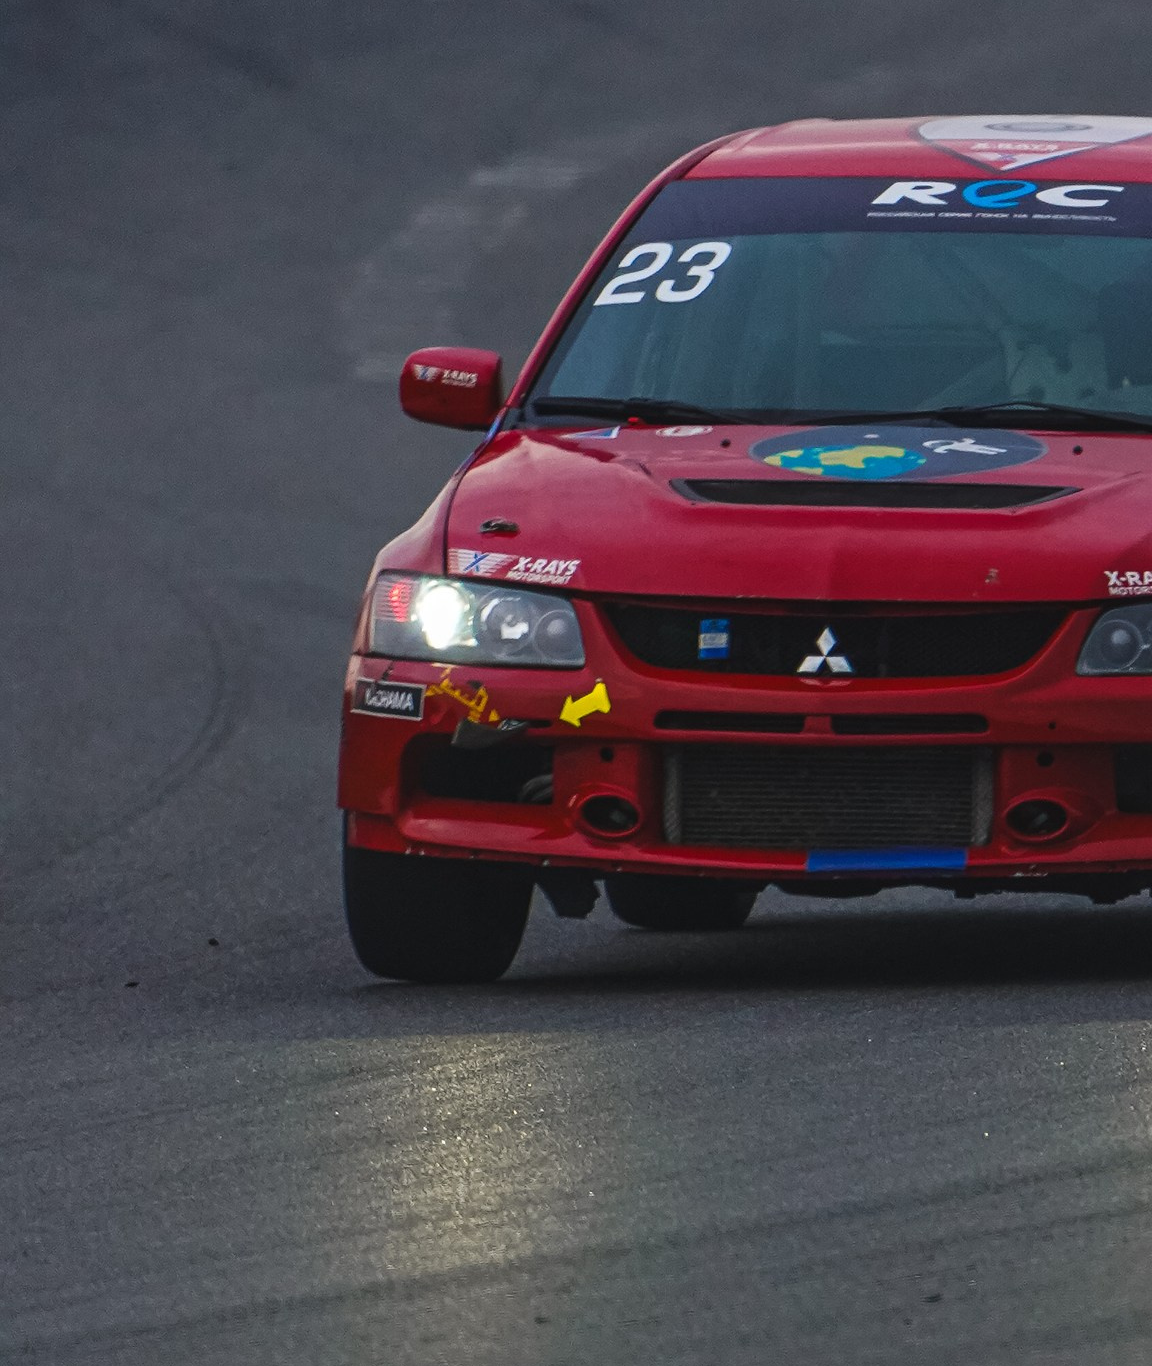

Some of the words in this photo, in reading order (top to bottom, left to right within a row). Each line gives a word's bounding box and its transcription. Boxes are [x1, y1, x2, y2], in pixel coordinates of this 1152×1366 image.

[593, 241, 733, 306] 23
[511, 556, 581, 576] X-RAYS
[505, 570, 573, 585] MOTORSPORT
